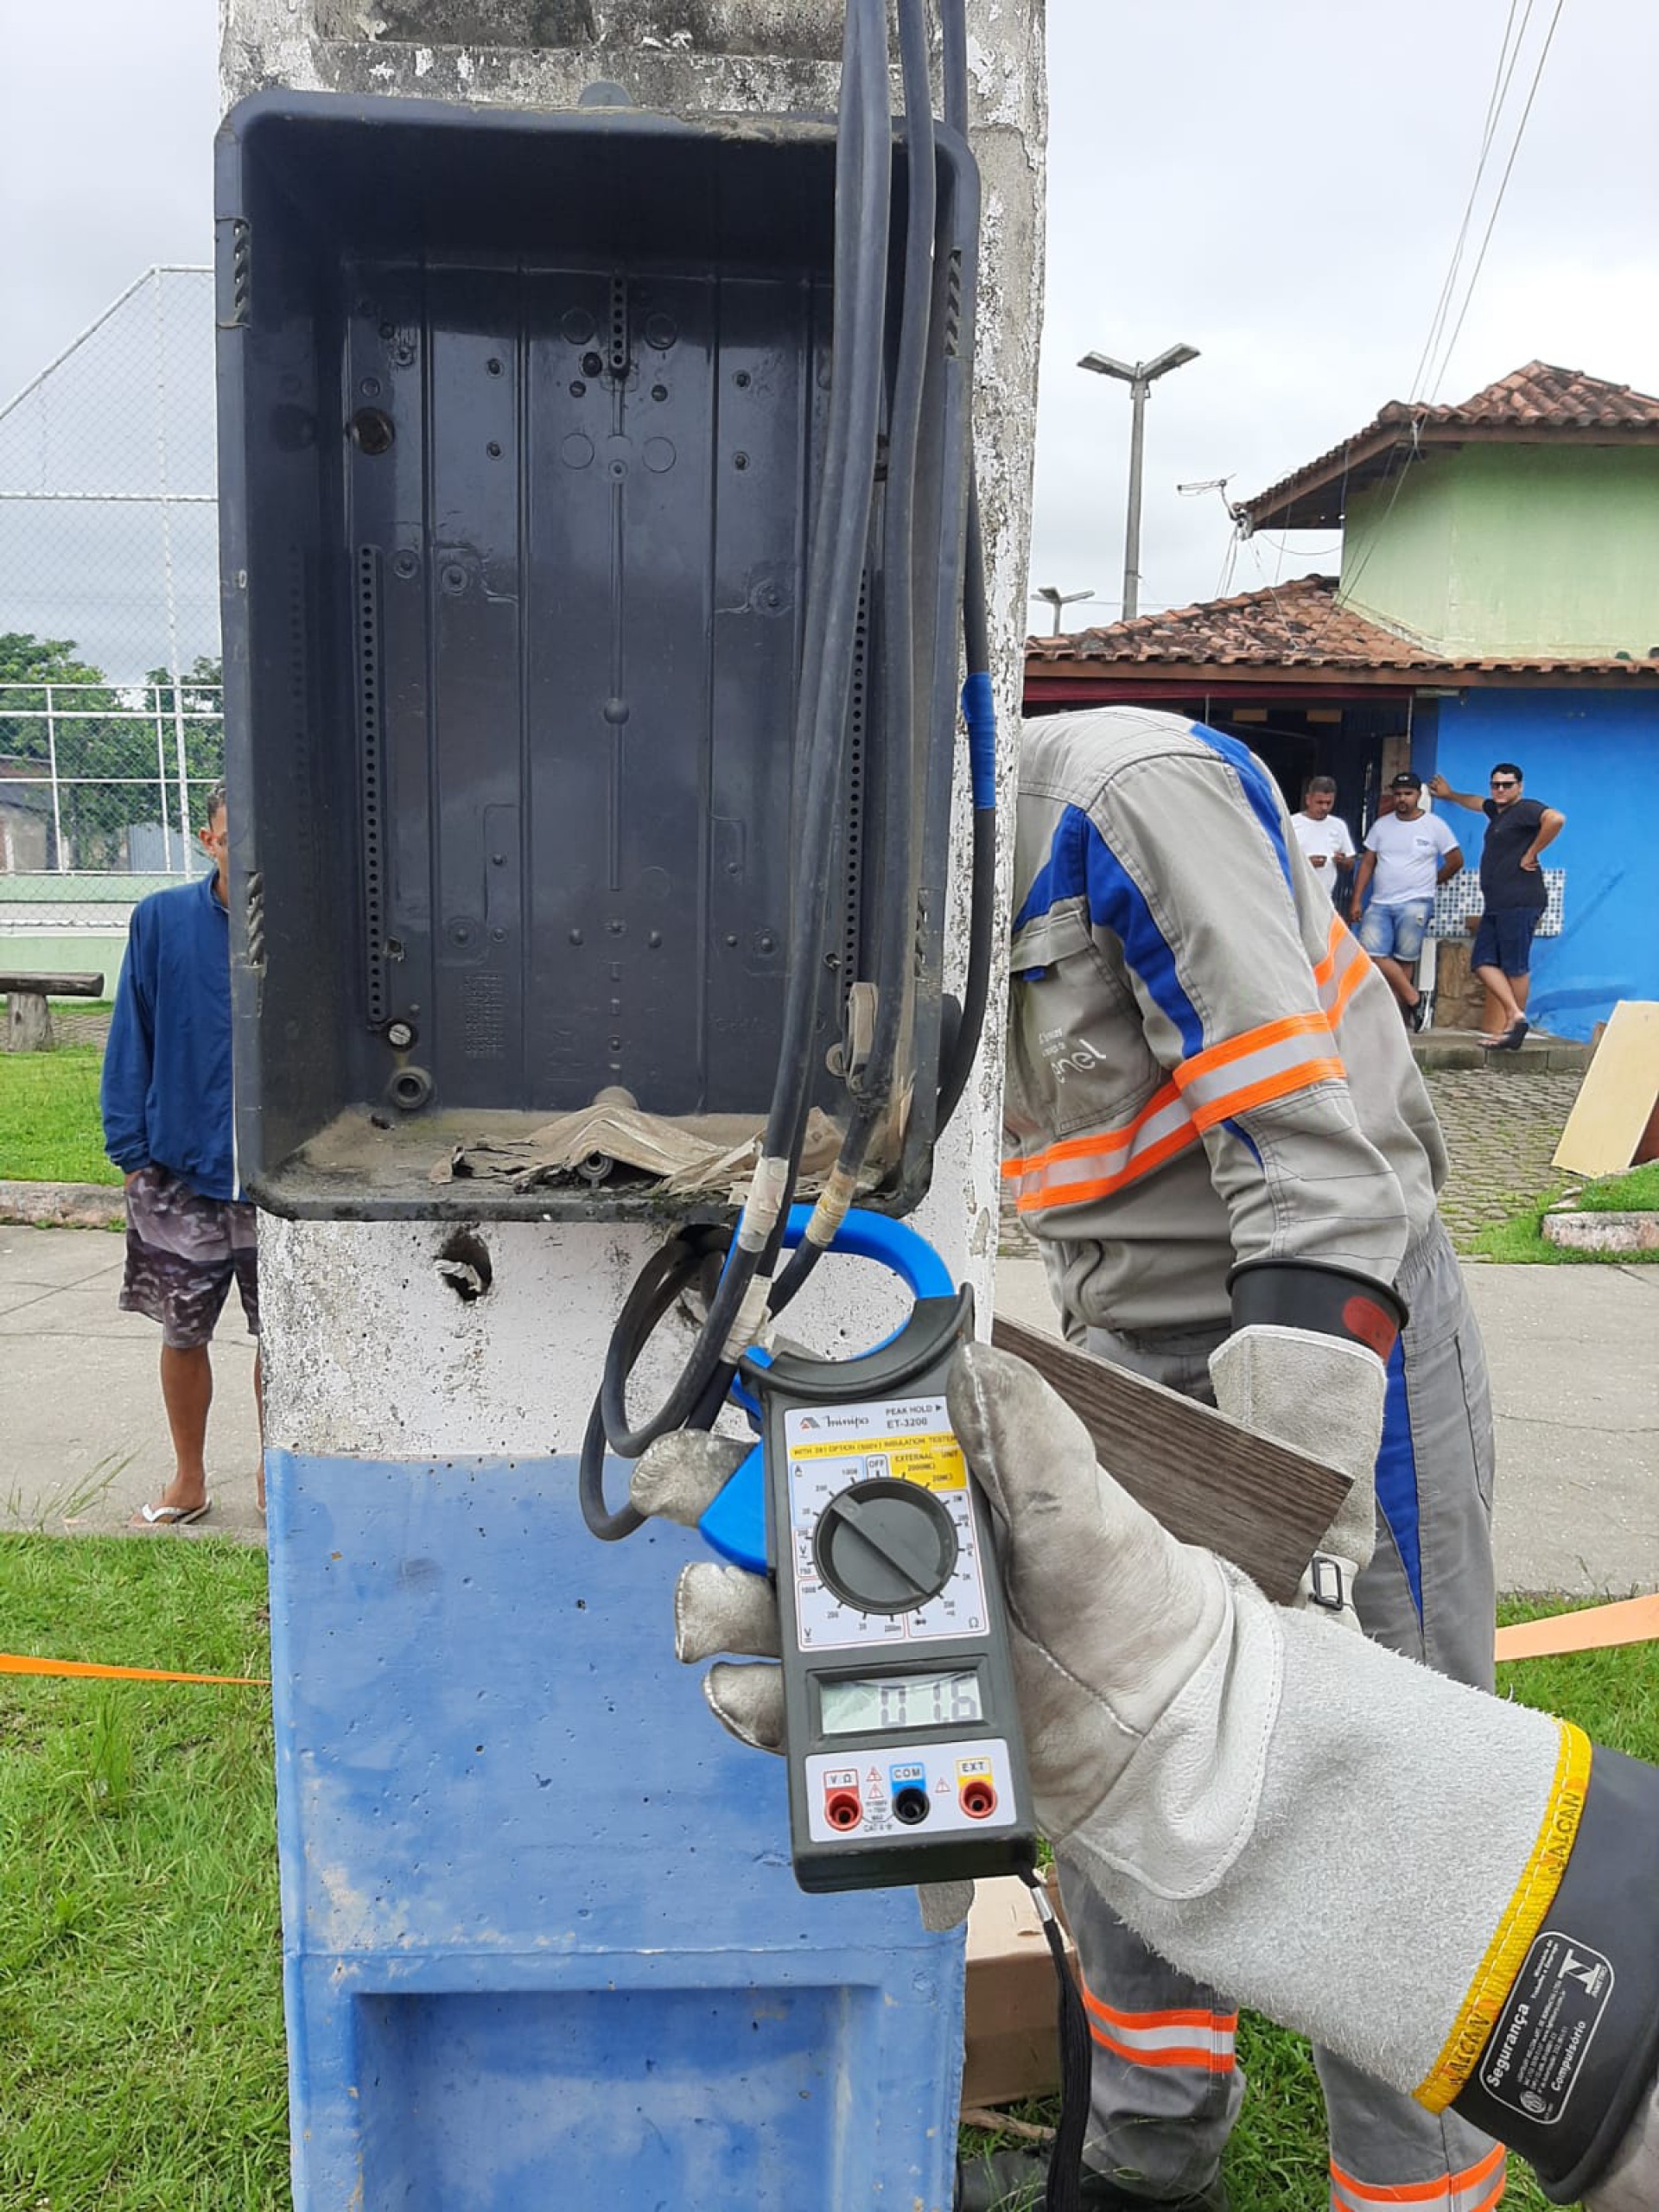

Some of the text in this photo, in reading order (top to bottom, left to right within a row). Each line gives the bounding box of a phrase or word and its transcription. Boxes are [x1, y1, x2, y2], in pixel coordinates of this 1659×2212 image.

[886, 1404, 932, 1416] PEAK HOLD
[868, 1459, 885, 1469] OFF
[961, 1762, 984, 1771] EXT
[893, 1768, 920, 1778] COM
[1486, 2003, 1529, 2088] Segurança
[1550, 2020, 1586, 2092] Compulsório
